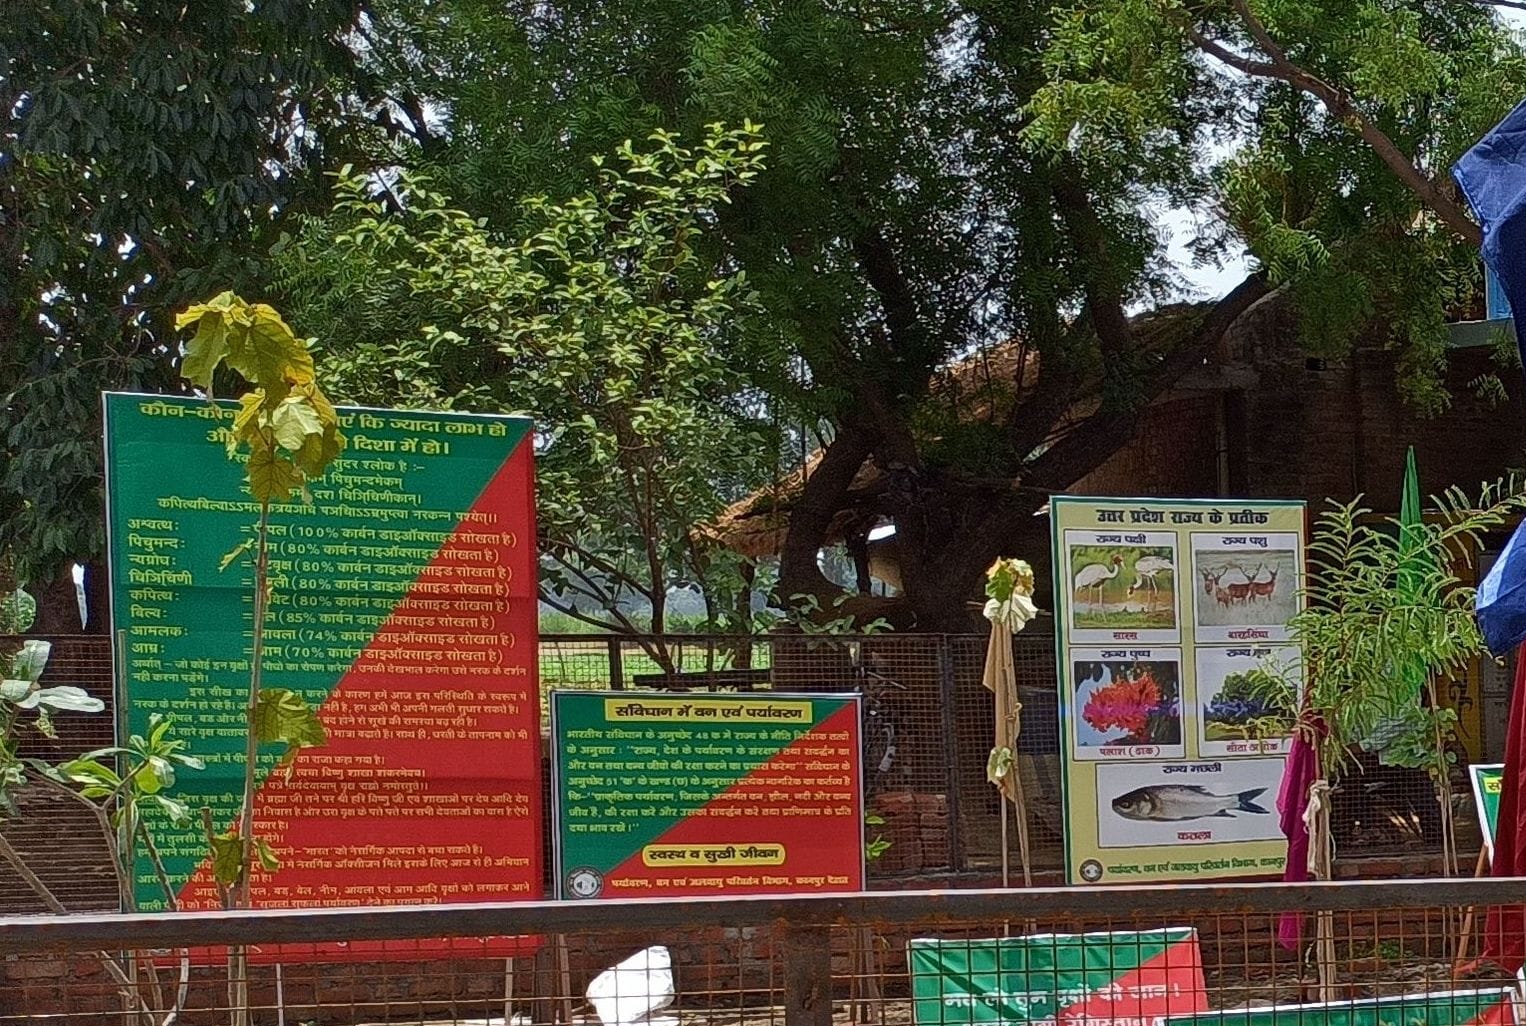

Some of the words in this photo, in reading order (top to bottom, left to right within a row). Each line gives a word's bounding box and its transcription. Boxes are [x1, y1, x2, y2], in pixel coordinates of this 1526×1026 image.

[359, 413, 385, 429] कि
[390, 418, 440, 433] ज्यादा
[445, 422, 483, 435] लाभ
[488, 421, 507, 437] हो
[354, 434, 395, 452] दिशा
[400, 437, 420, 452] में
[1096, 509, 1125, 523] उत्तर
[1130, 507, 1165, 524] प्रदेश
[1170, 511, 1203, 524] राज्य
[1208, 508, 1223, 524] के
[1227, 509, 1270, 525] प्रतीक
[676, 704, 693, 717] में
[694, 707, 717, 717] वन
[721, 705, 744, 718] एवं
[746, 705, 803, 718] पर्यावरण
[704, 846, 736, 863] सुखी
[740, 846, 779, 859] जीवन
